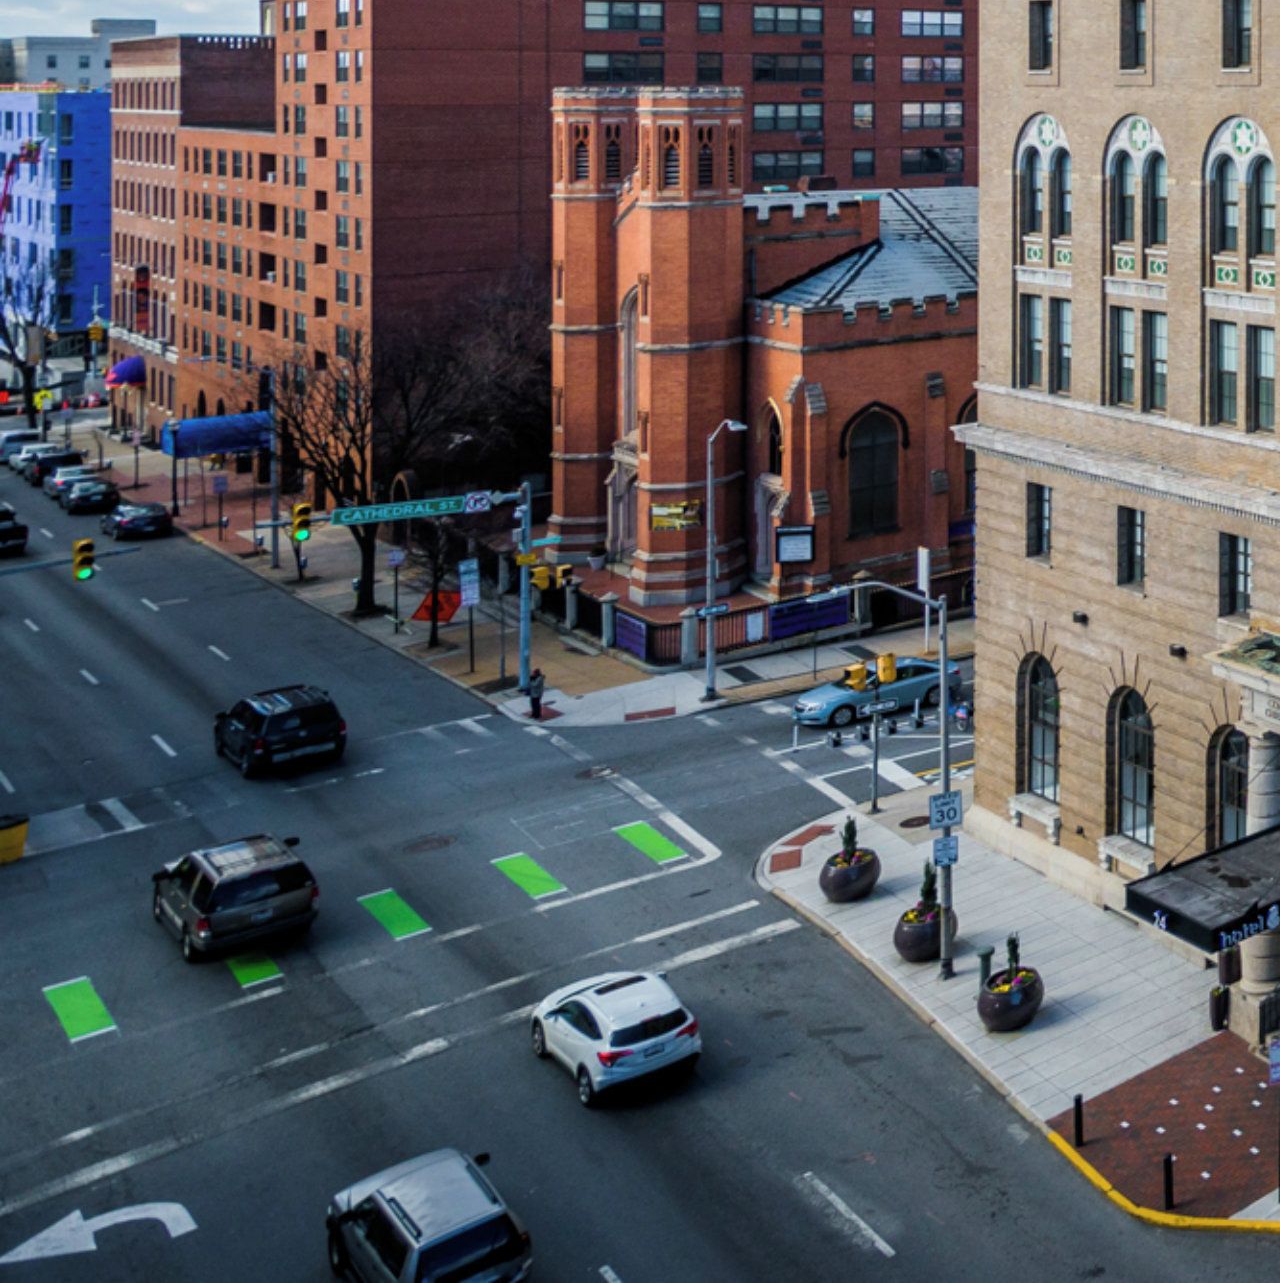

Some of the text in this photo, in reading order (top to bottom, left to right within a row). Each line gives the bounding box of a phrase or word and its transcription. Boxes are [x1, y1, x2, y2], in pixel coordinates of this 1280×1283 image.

[341, 503, 434, 522] CATHEDRAL
[935, 807, 957, 823] 30
[1219, 915, 1264, 950] hotel
